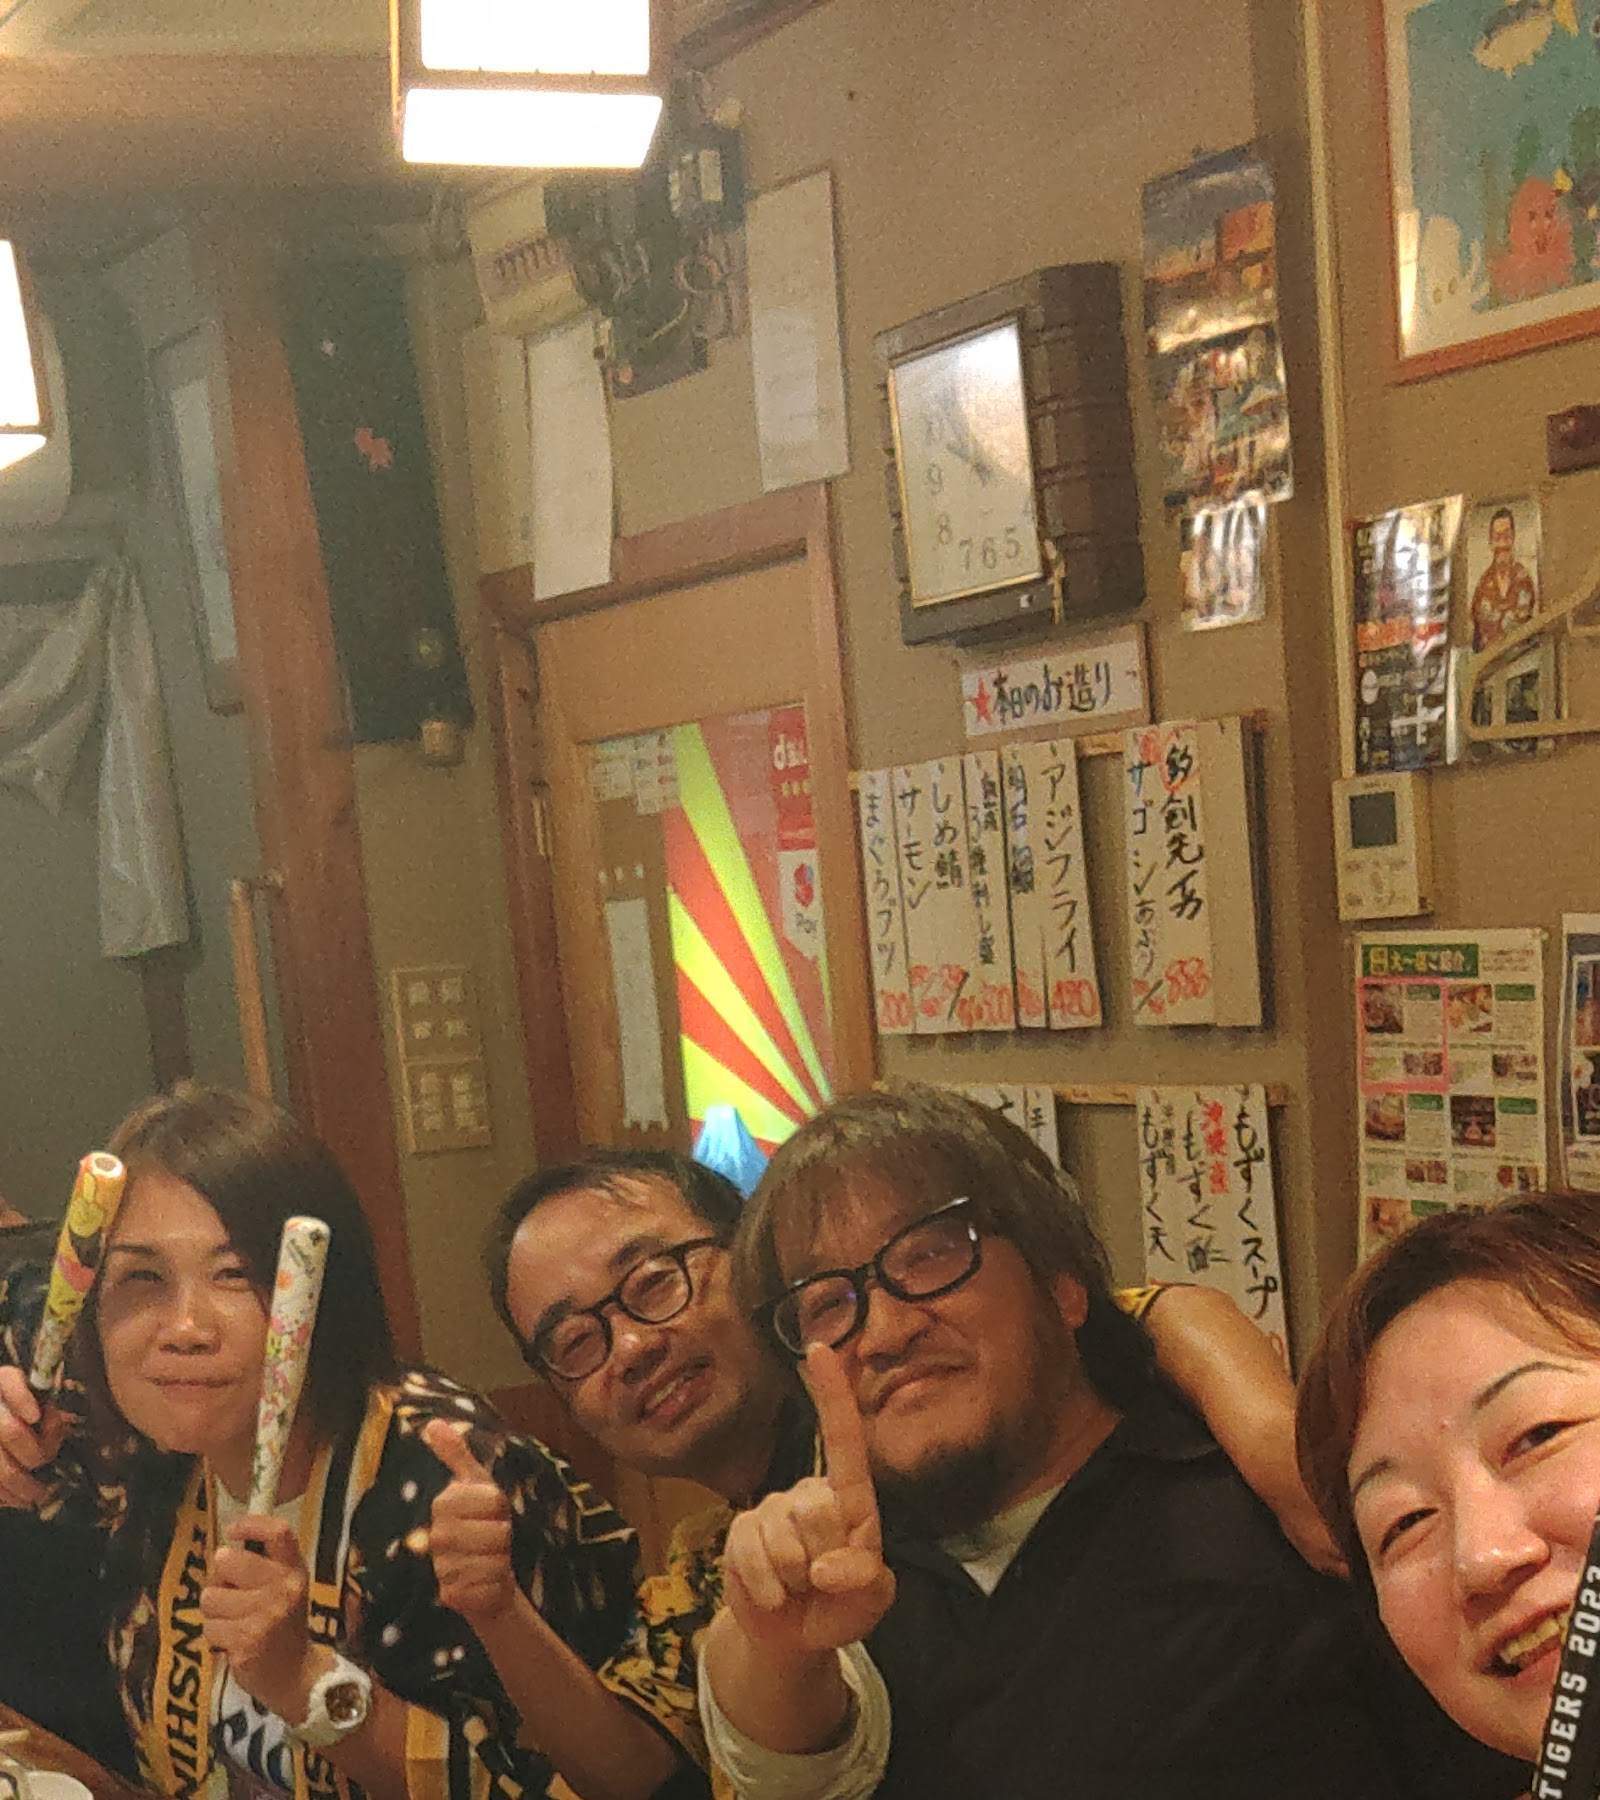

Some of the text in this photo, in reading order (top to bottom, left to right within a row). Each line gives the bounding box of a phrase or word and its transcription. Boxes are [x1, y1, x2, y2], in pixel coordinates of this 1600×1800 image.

[925, 462, 943, 496] 9
[1004, 525, 1021, 560] 5
[901, 786, 931, 910] サーモン
[1042, 763, 1079, 973] アジフライ
[1234, 1104, 1278, 1319] もずくスープ
